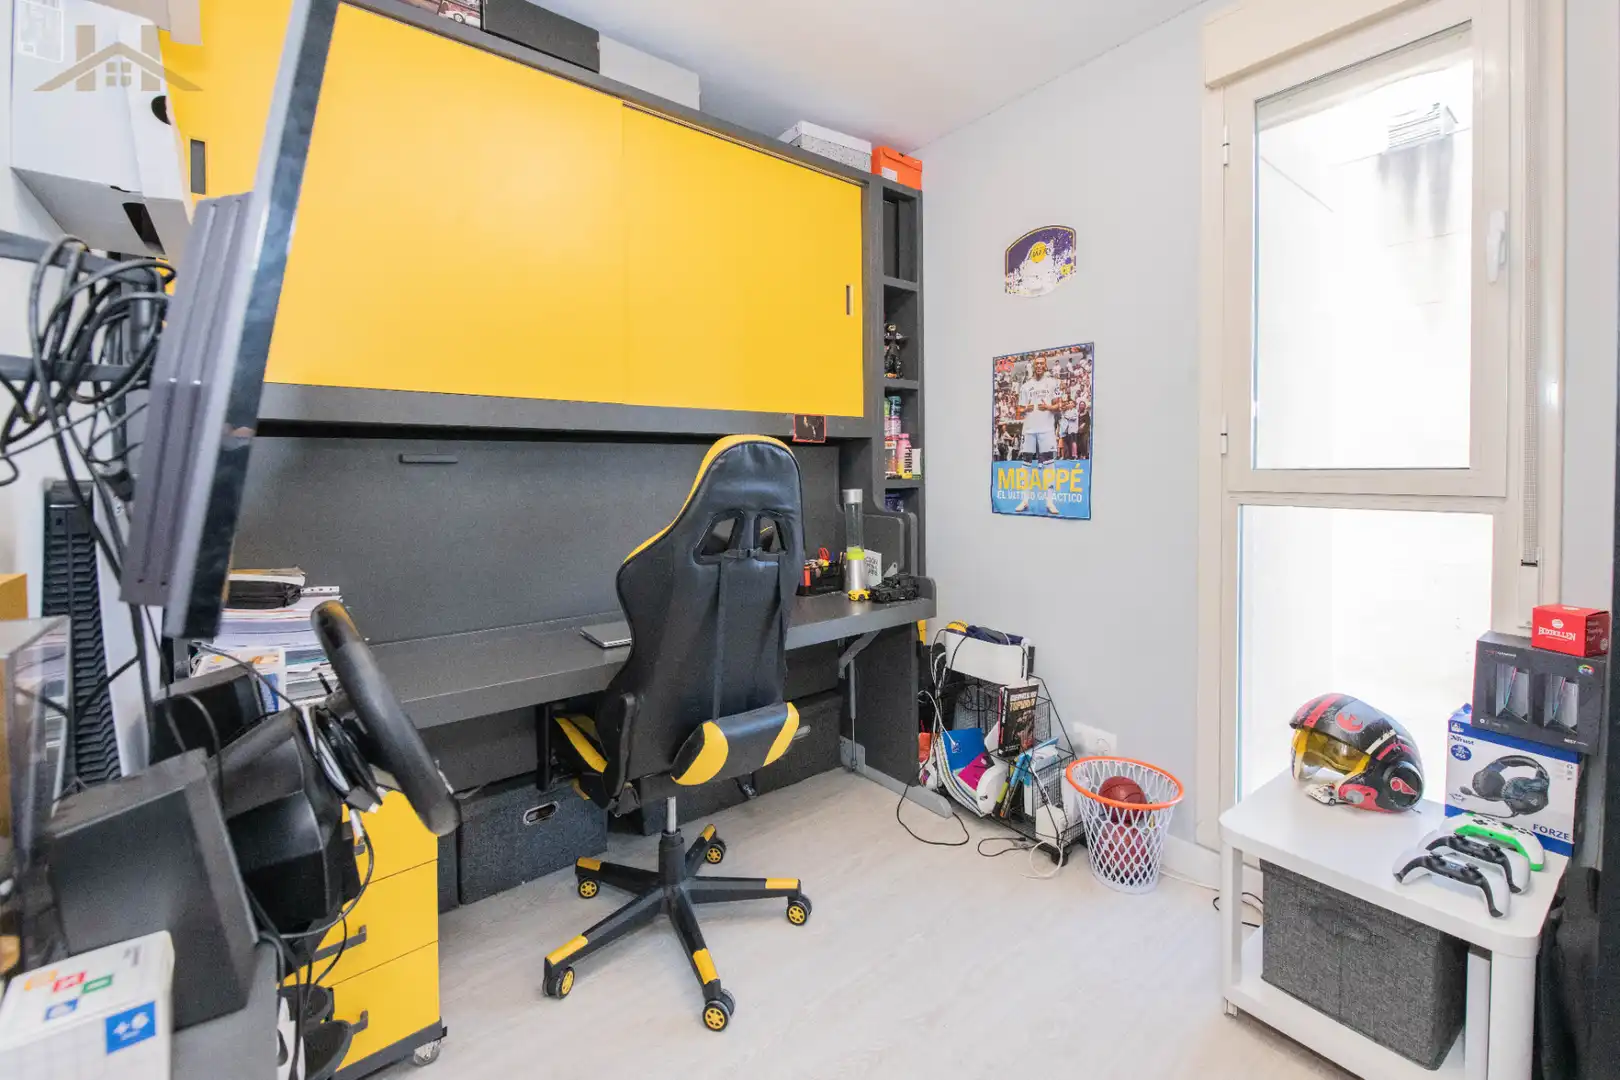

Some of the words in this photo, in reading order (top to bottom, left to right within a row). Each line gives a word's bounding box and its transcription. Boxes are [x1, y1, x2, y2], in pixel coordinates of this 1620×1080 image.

[904, 446, 913, 474] PRIME
[997, 463, 1084, 492] MBAPPÉ
[997, 490, 1006, 500] EL
[1533, 823, 1569, 841] FORZE
